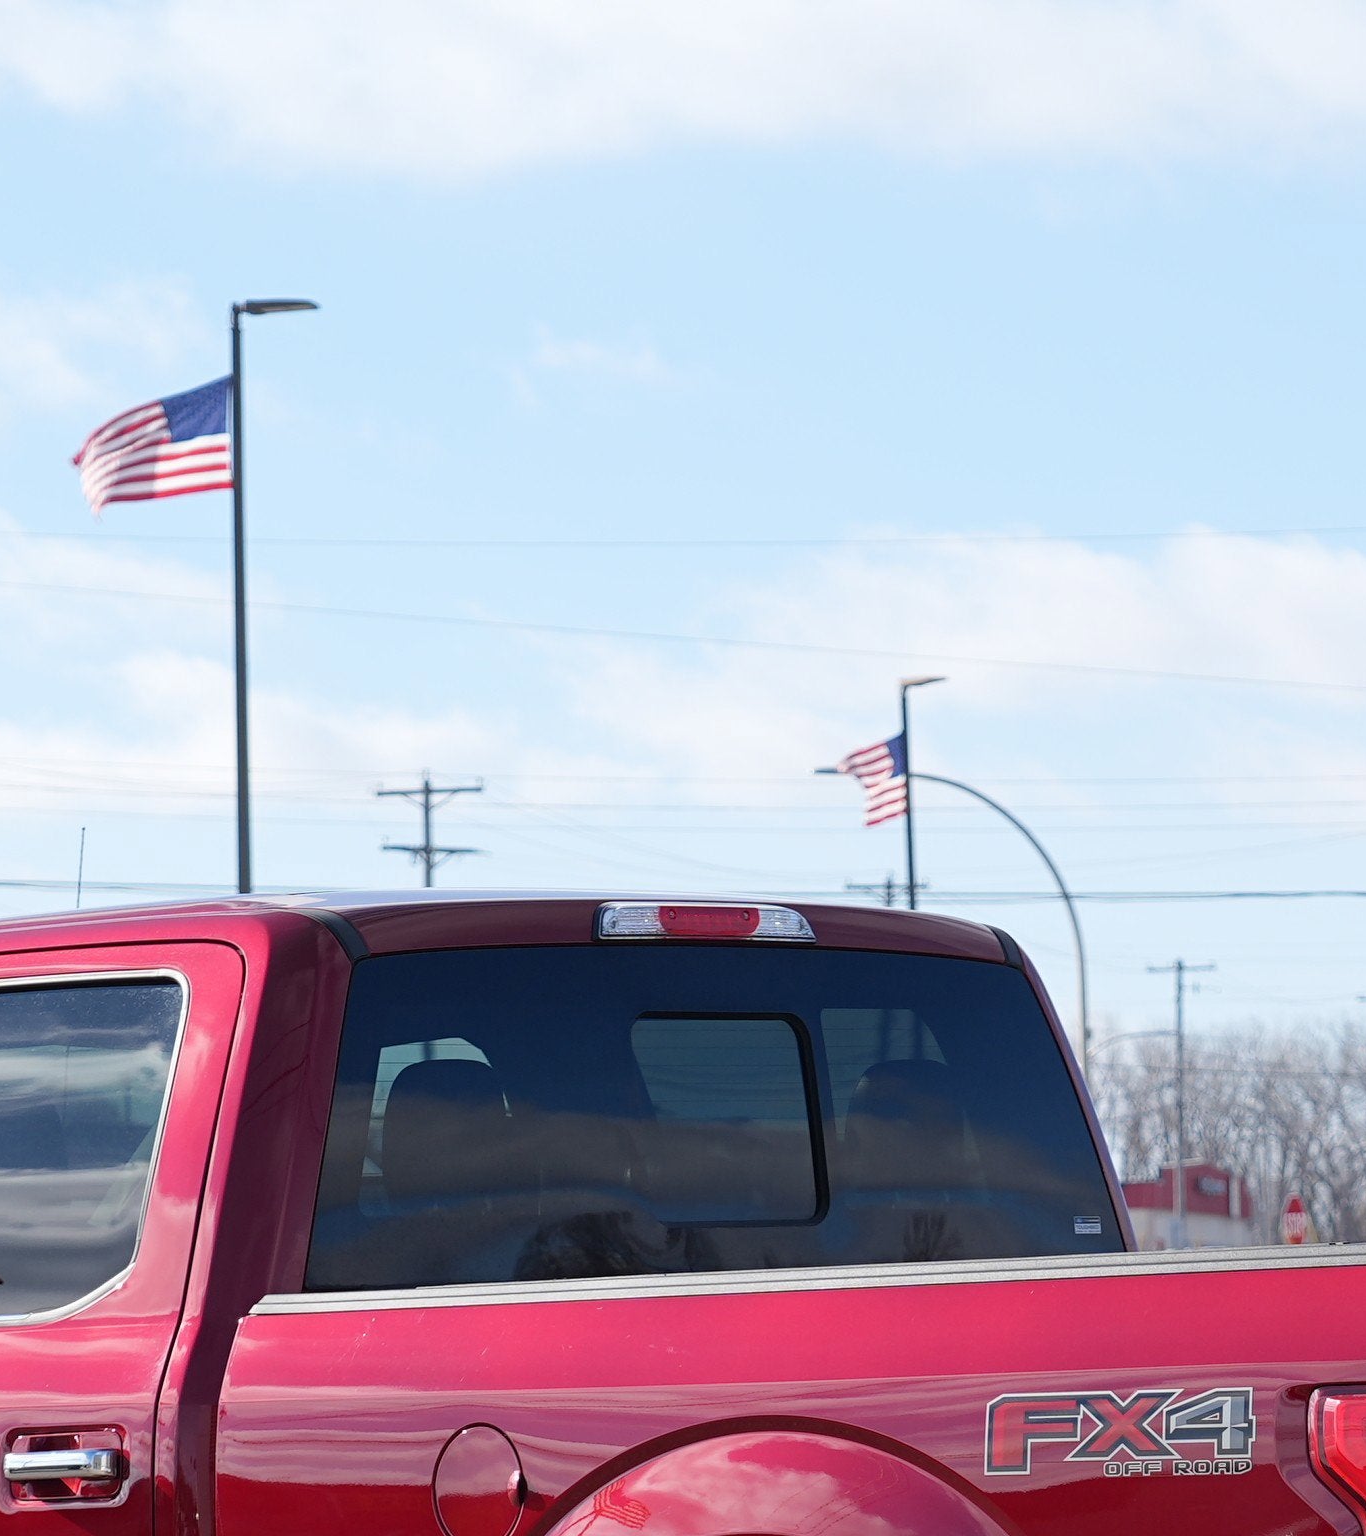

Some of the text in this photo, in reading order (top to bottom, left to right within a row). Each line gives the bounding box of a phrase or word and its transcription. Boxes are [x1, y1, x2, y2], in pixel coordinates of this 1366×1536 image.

[985, 1387, 1256, 1475] FX4
[1103, 1458, 1252, 1477] OFF ROAD
